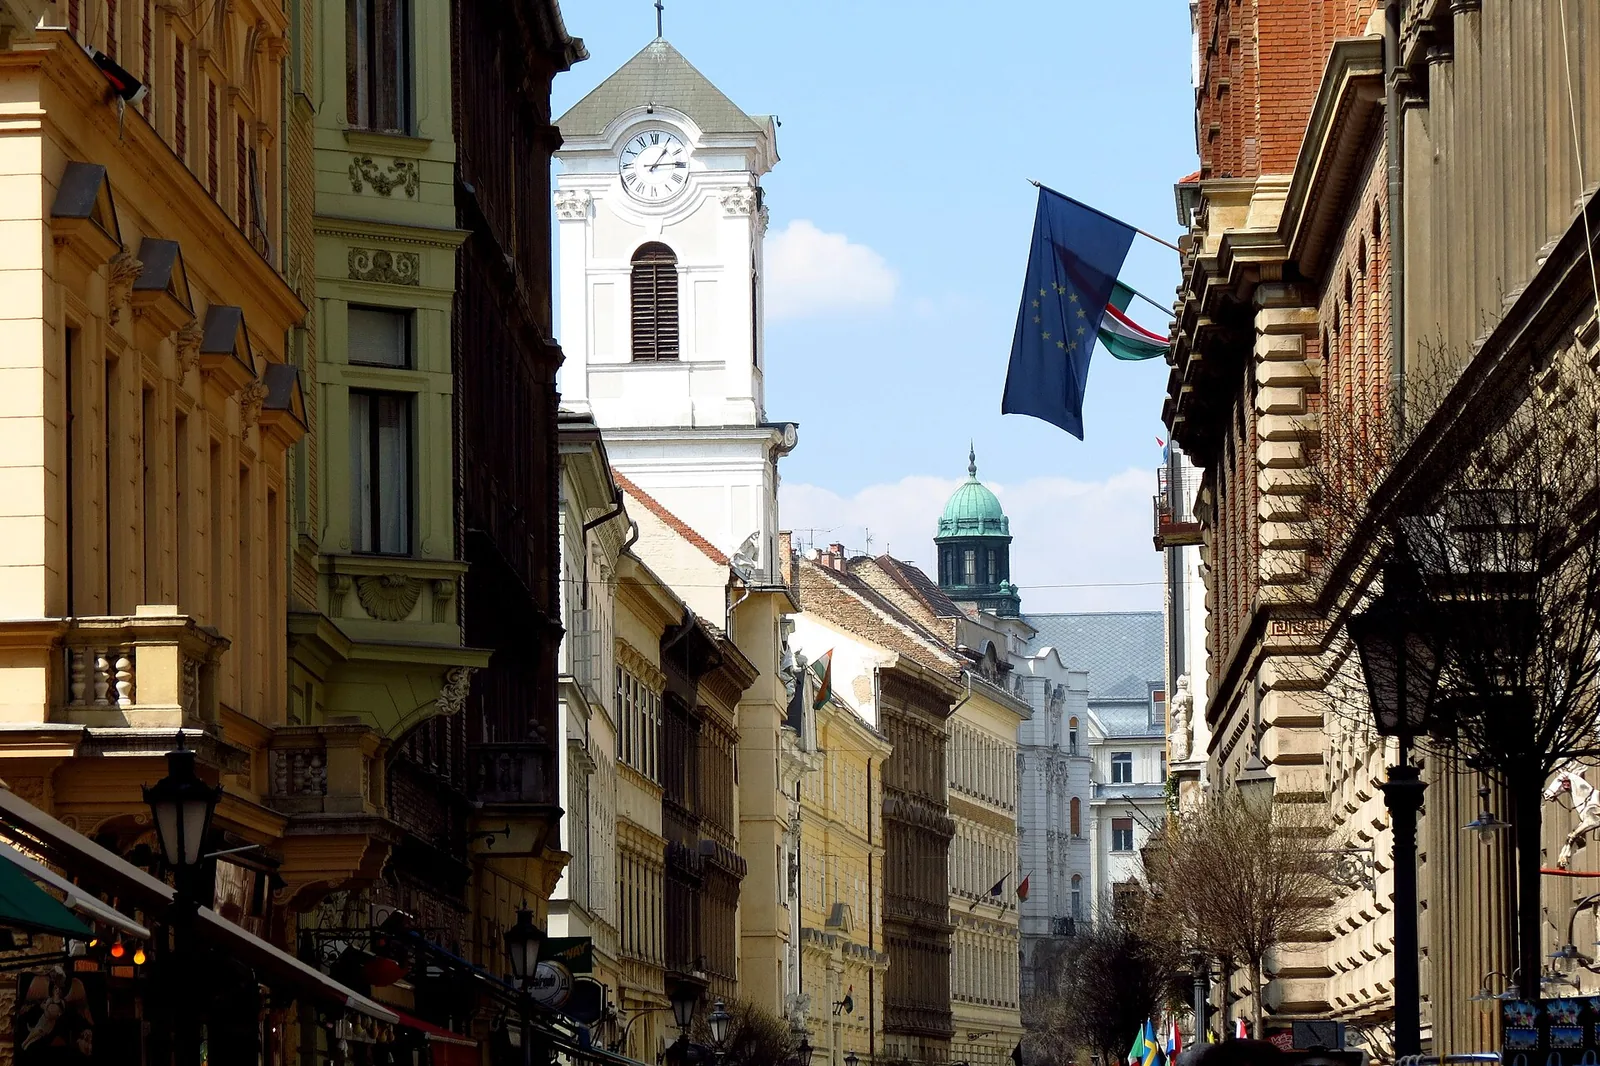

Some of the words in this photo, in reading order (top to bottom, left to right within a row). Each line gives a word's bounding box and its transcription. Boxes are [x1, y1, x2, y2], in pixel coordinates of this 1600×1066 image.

[636, 136, 647, 149] XI
[650, 133, 660, 145] XII
[625, 148, 638, 157] X
